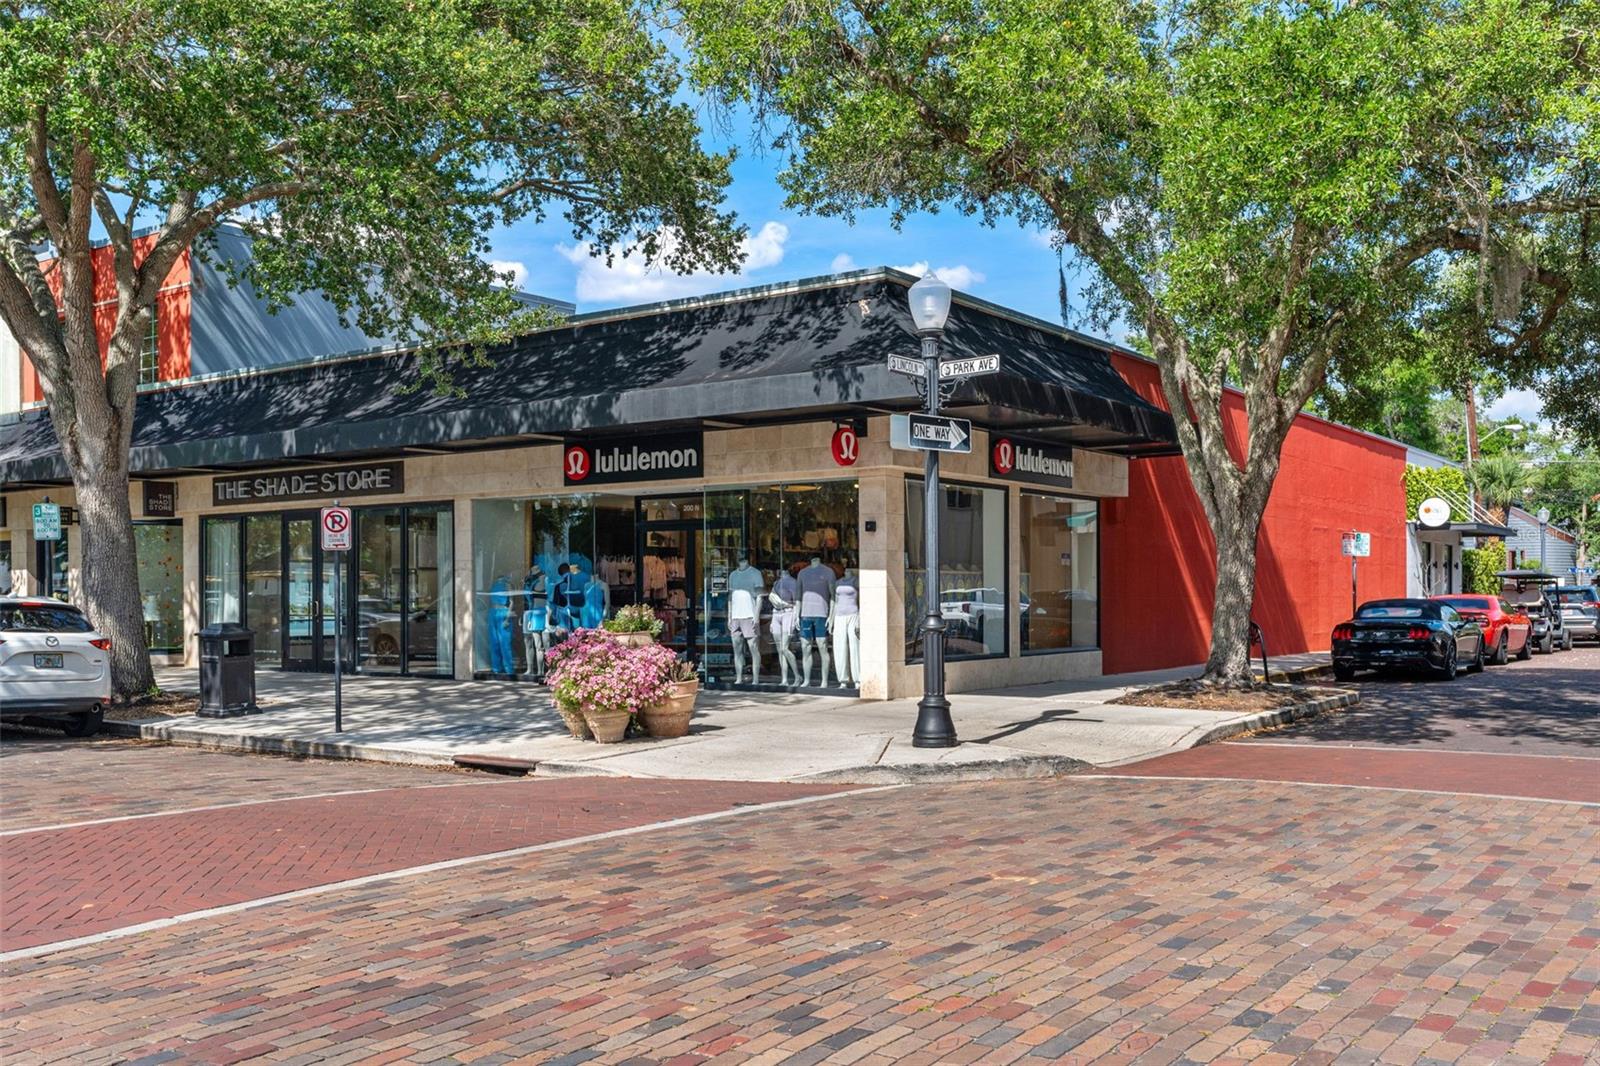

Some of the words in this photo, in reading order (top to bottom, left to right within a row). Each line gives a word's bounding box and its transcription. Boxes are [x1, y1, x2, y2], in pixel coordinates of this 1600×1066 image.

[897, 359, 918, 373] LINCOLN
[953, 362, 976, 374] PARK
[979, 358, 994, 370] AVE
[914, 424, 931, 438] ONE
[934, 427, 951, 440] WAY
[595, 445, 698, 474] lululemon
[1015, 445, 1074, 478] lululemon
[214, 480, 252, 500] THE
[253, 474, 318, 498] SHADE
[320, 468, 391, 493] STORE
[34, 506, 41, 516] 3
[683, 504, 693, 512] 200
